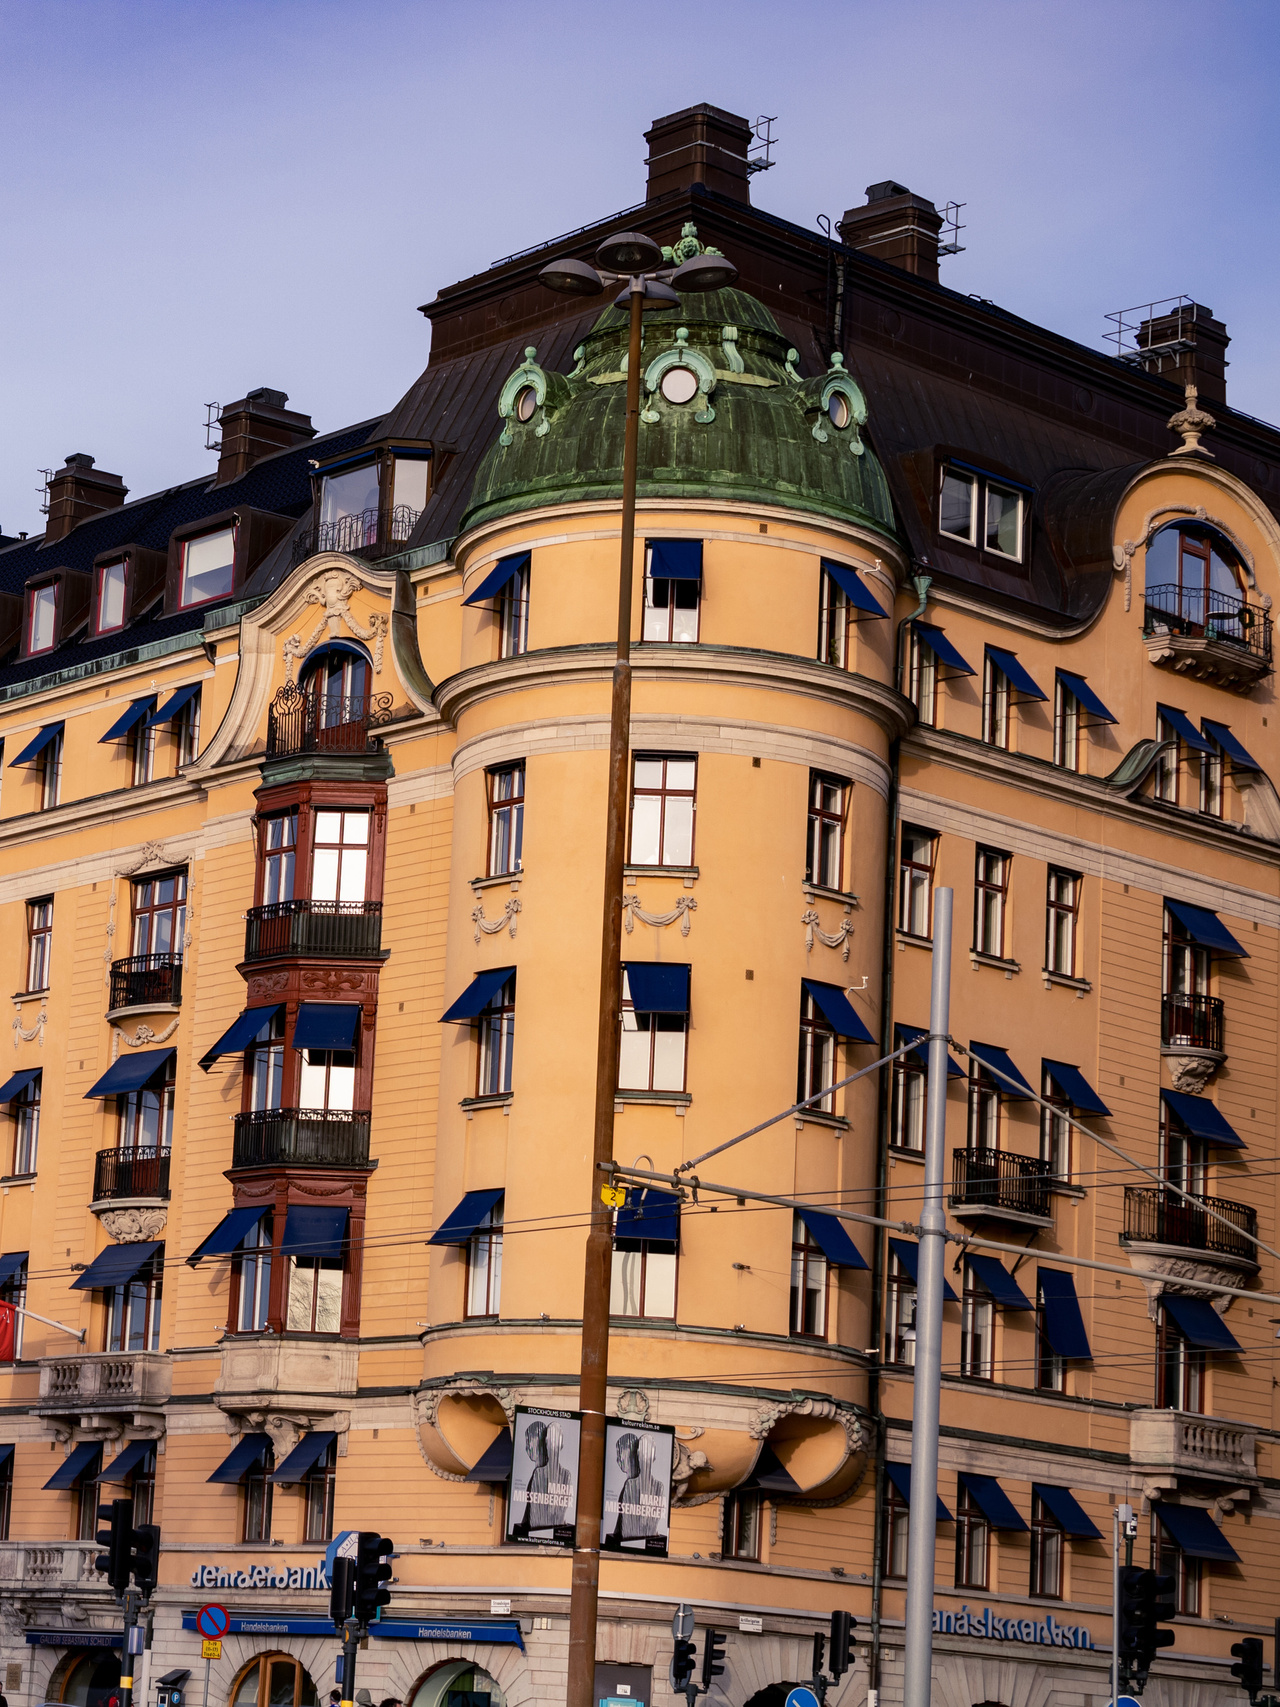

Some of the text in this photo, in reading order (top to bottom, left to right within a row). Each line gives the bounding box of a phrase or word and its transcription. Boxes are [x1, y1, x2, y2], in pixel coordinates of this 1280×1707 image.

[610, 1192, 617, 1201] 2
[527, 1407, 572, 1419] STOCKHOLMS STAD
[621, 1419, 660, 1431] kulturreklam.se
[548, 1482, 574, 1497] MARIA
[513, 1490, 573, 1508] MIESENBERGER
[640, 1493, 666, 1508] MARIA
[605, 1501, 666, 1519] MIESENBERGER
[240, 1621, 289, 1632] Handelsbanken
[418, 1627, 472, 1639] Handelsbanken
[40, 1635, 113, 1646] GALLERI SEBASTIAN SCHILDT
